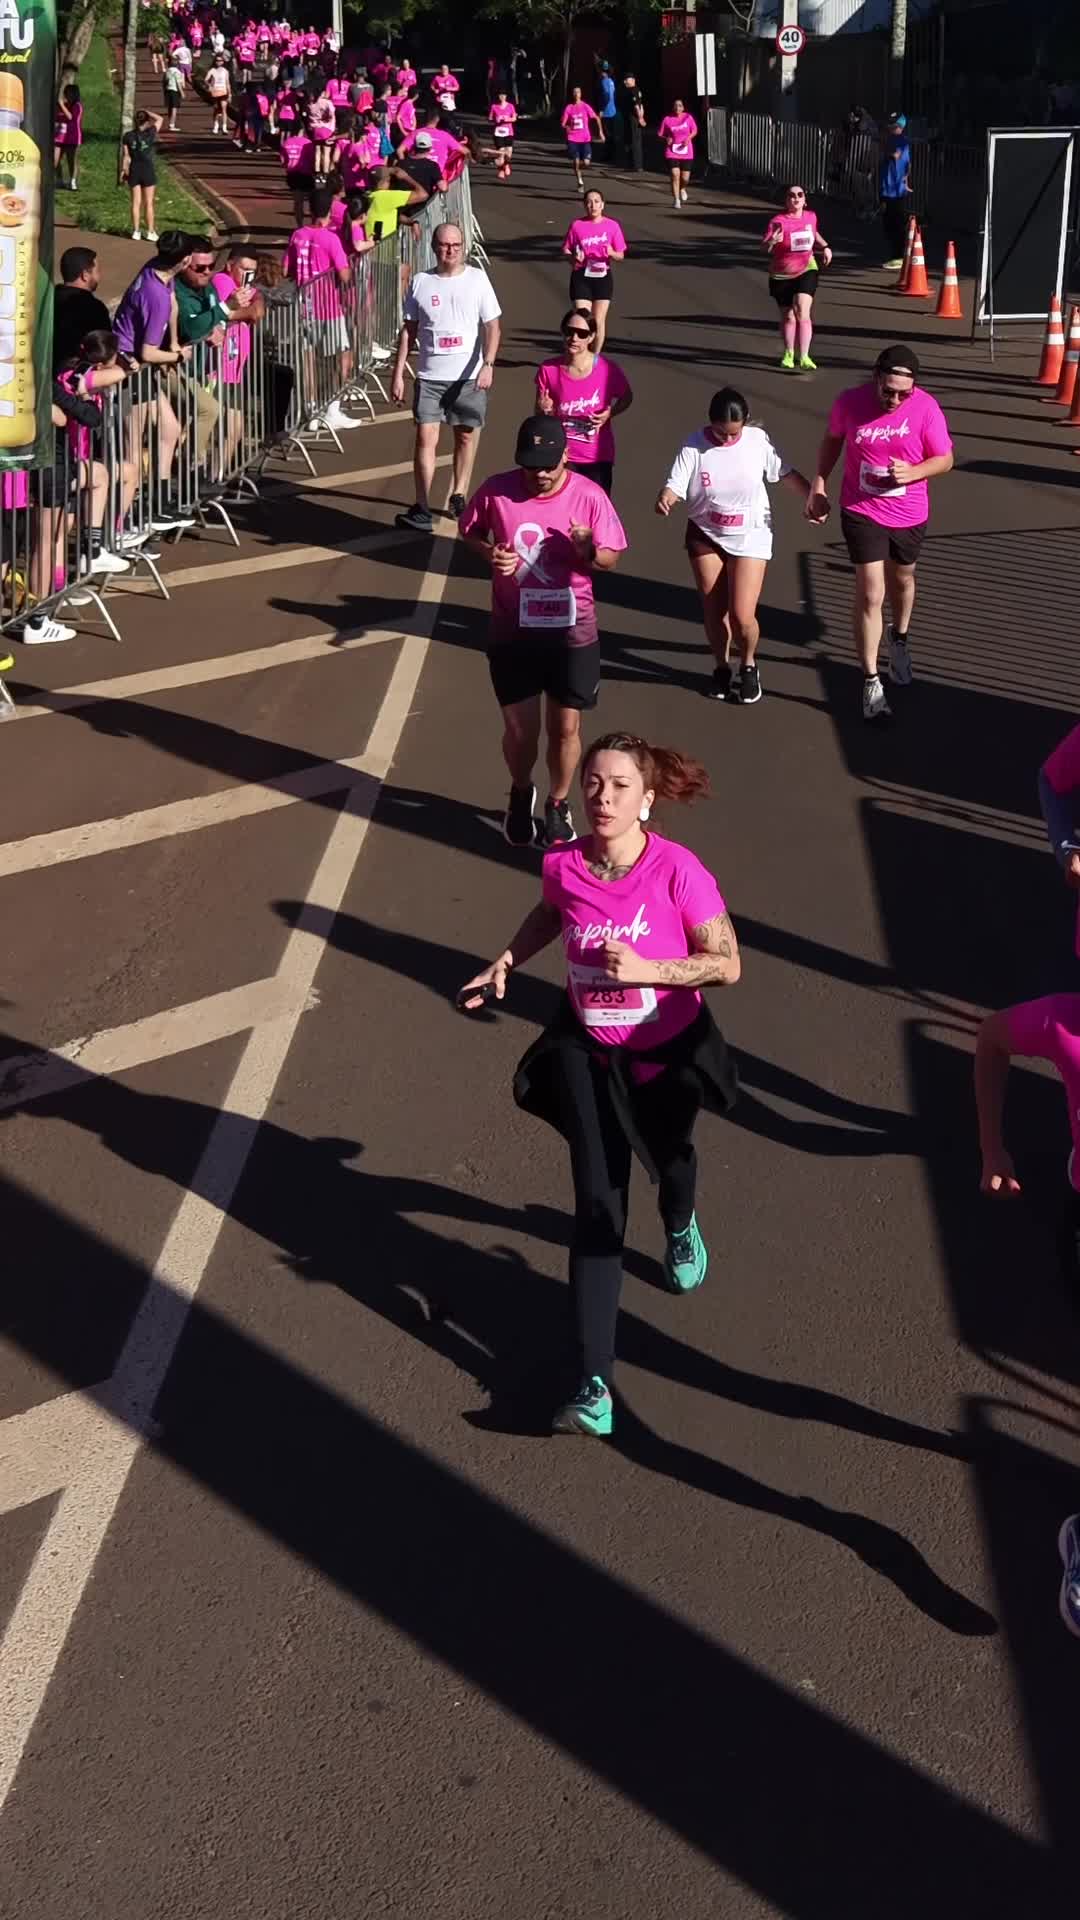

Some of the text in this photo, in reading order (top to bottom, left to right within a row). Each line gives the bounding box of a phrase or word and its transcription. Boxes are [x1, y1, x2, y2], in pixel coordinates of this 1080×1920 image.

[781, 31, 800, 43] 40
[431, 295, 440, 306] B
[701, 472, 711, 487] B
[589, 986, 626, 1004] 283
